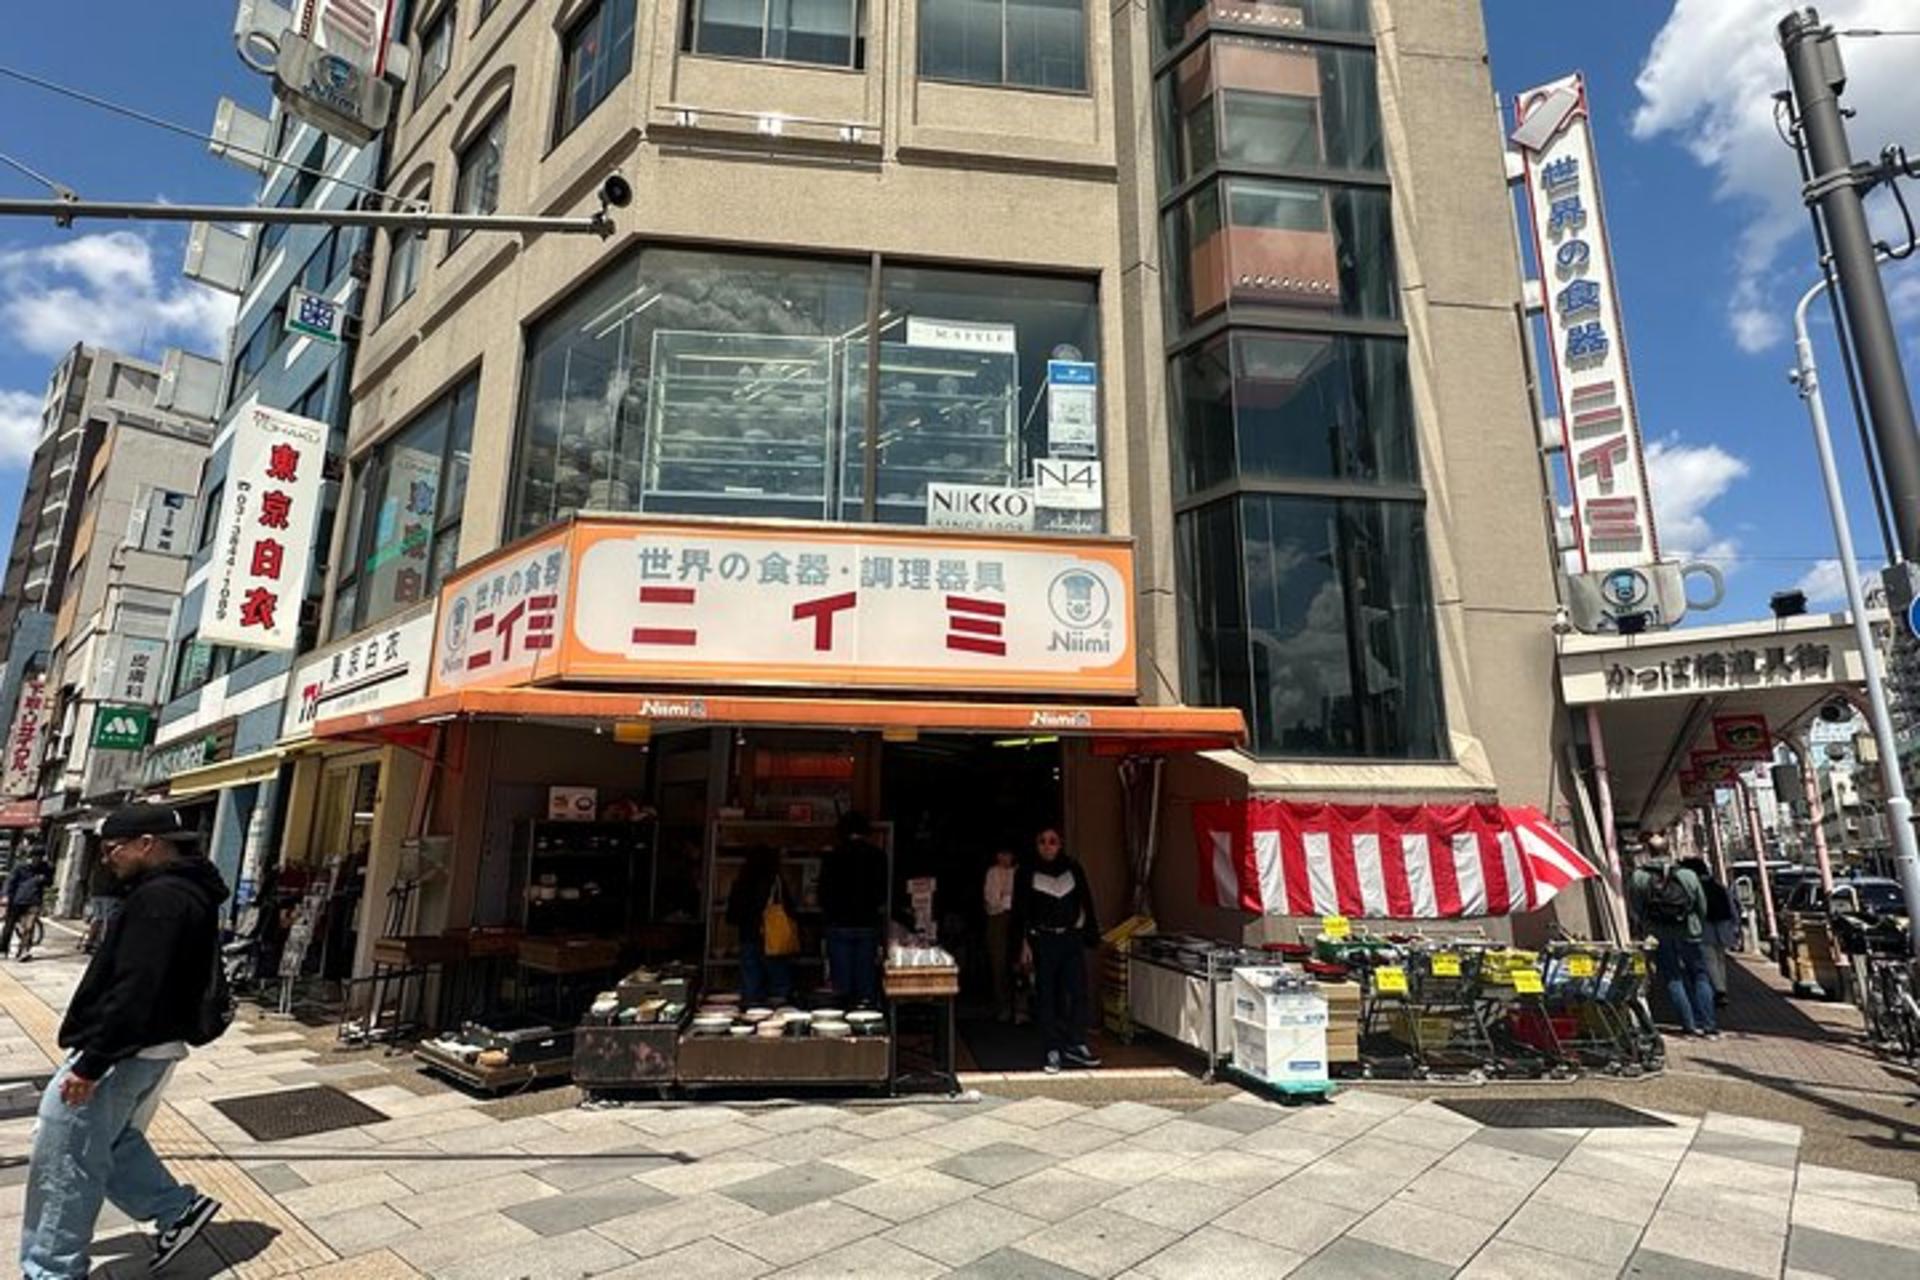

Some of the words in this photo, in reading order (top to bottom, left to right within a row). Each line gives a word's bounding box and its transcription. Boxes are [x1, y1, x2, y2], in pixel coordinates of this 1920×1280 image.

[1542, 155, 1609, 362] 世界の食器
[1037, 463, 1097, 488] N4
[1572, 380, 1642, 546] ニイミ
[933, 491, 1028, 517] NIKKO
[239, 442, 300, 629] 東京白衣
[475, 551, 562, 612] 世界の食器
[639, 547, 1005, 592] 世界の食器・調理器具
[467, 594, 558, 671] ニイミ
[632, 586, 1006, 657] ニイミ
[1047, 630, 1111, 653] Niimi
[329, 631, 400, 682] 東京白衣
[638, 698, 689, 716] Niimi
